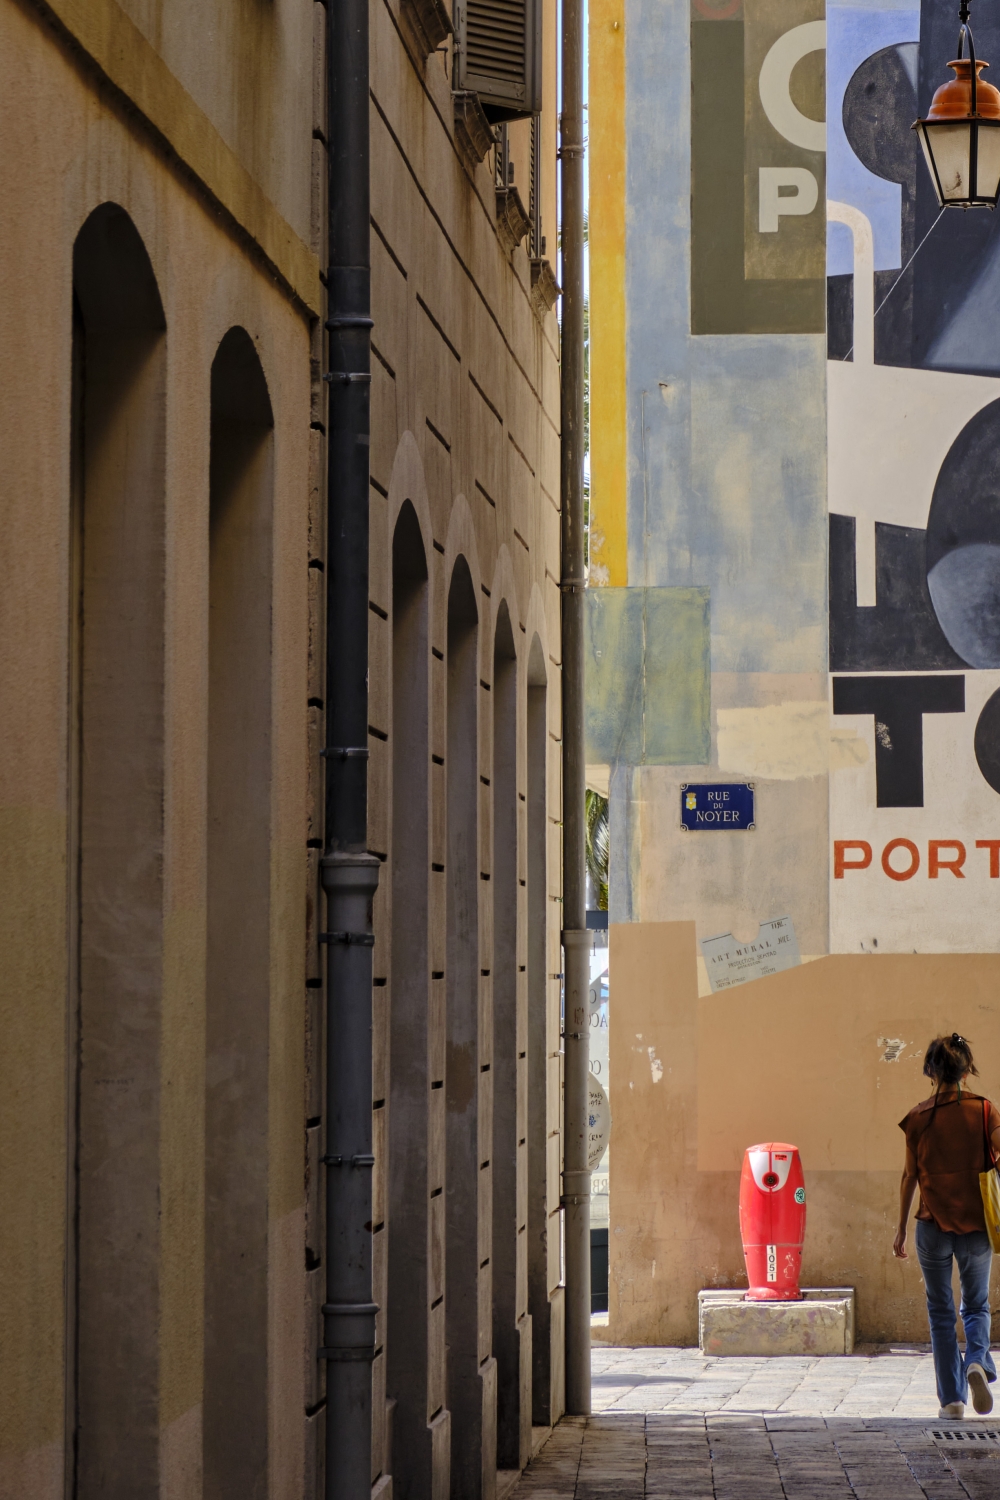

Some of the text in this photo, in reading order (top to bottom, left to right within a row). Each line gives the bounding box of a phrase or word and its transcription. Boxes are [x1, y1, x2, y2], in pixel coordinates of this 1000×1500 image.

[759, 167, 818, 232] P
[707, 791, 730, 801] RUE
[695, 810, 740, 822] NOYER
[735, 940, 772, 957] MURAL
[768, 1246, 776, 1281] 1051
